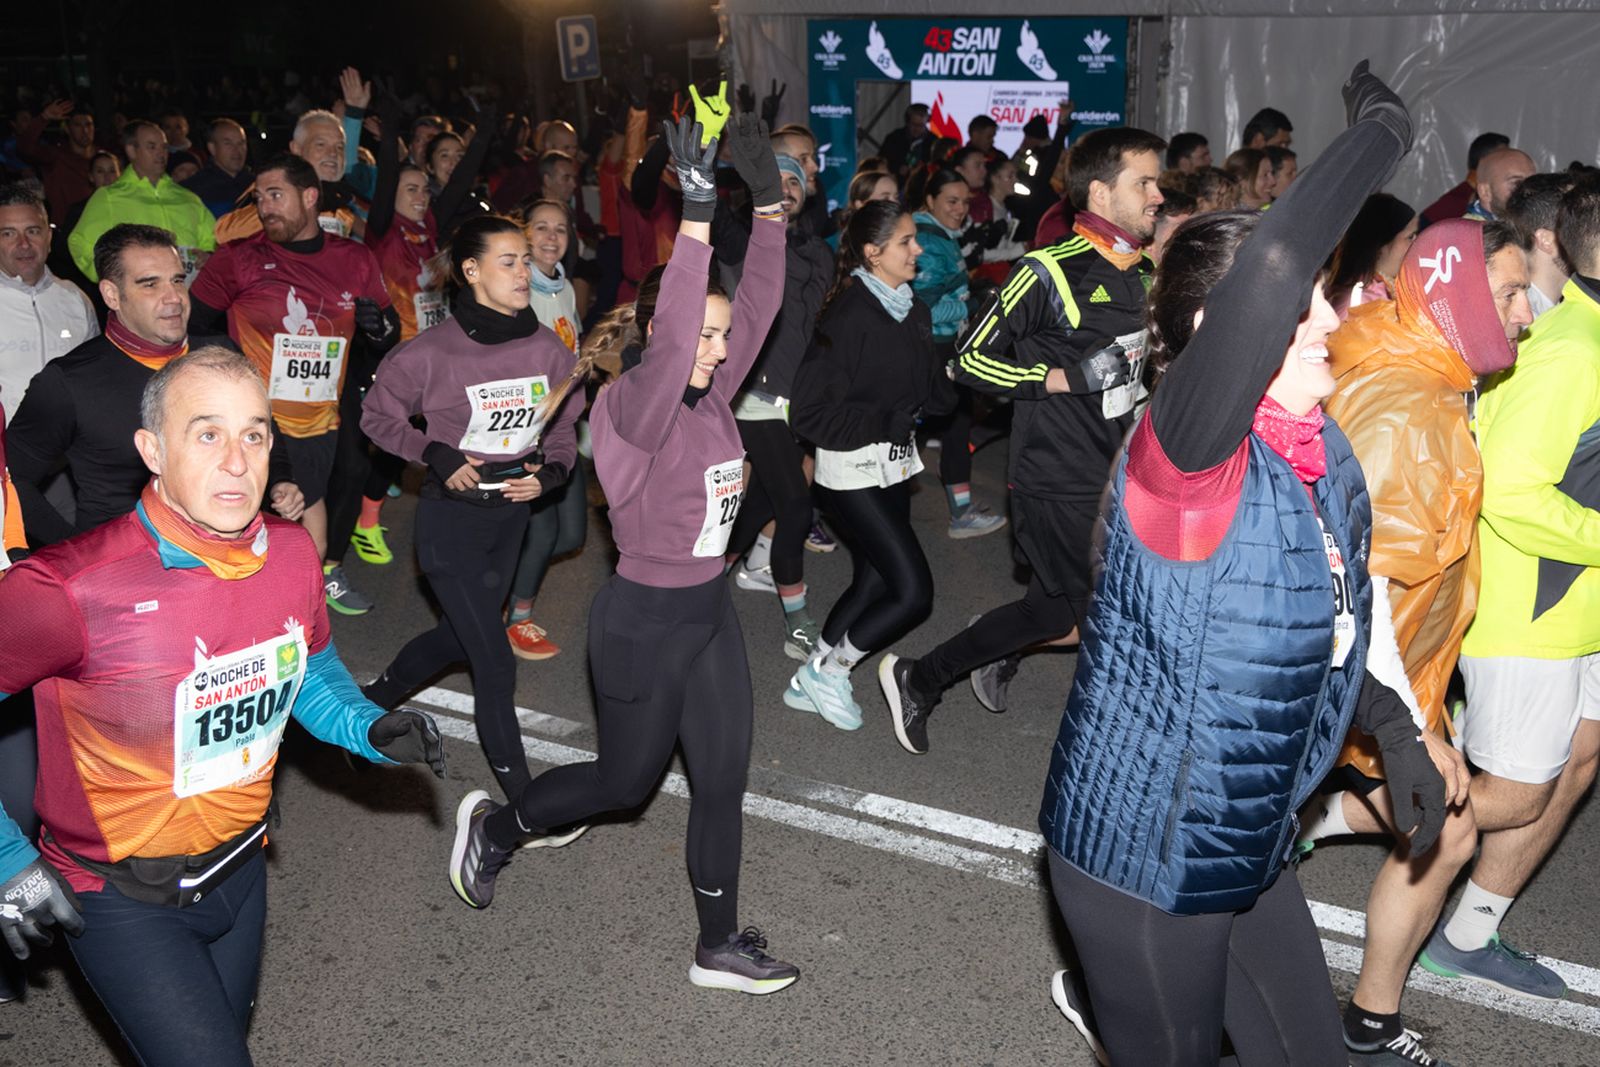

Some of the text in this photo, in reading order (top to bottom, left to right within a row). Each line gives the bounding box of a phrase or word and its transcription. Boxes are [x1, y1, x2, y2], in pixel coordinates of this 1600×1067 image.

[566, 24, 590, 73] P
[924, 27, 1001, 52] 43 SAN
[917, 46, 996, 76] ANTÓN
[991, 107, 1025, 123] SAN
[1070, 110, 1120, 122] calderón
[282, 350, 296, 358] SAN
[291, 342, 312, 350] NOCHE
[287, 359, 331, 380] 6944
[490, 391, 514, 399] NOCHE
[516, 388, 525, 396] DE
[482, 401, 498, 411] SAN
[722, 470, 743, 483] NOCHE
[715, 487, 728, 498] SAN
[720, 492, 743, 526] 22
[210, 663, 250, 688] NOCHE
[252, 657, 266, 674] DE
[194, 674, 267, 710] SAN ANTÓN
[195, 679, 293, 747] 13504
